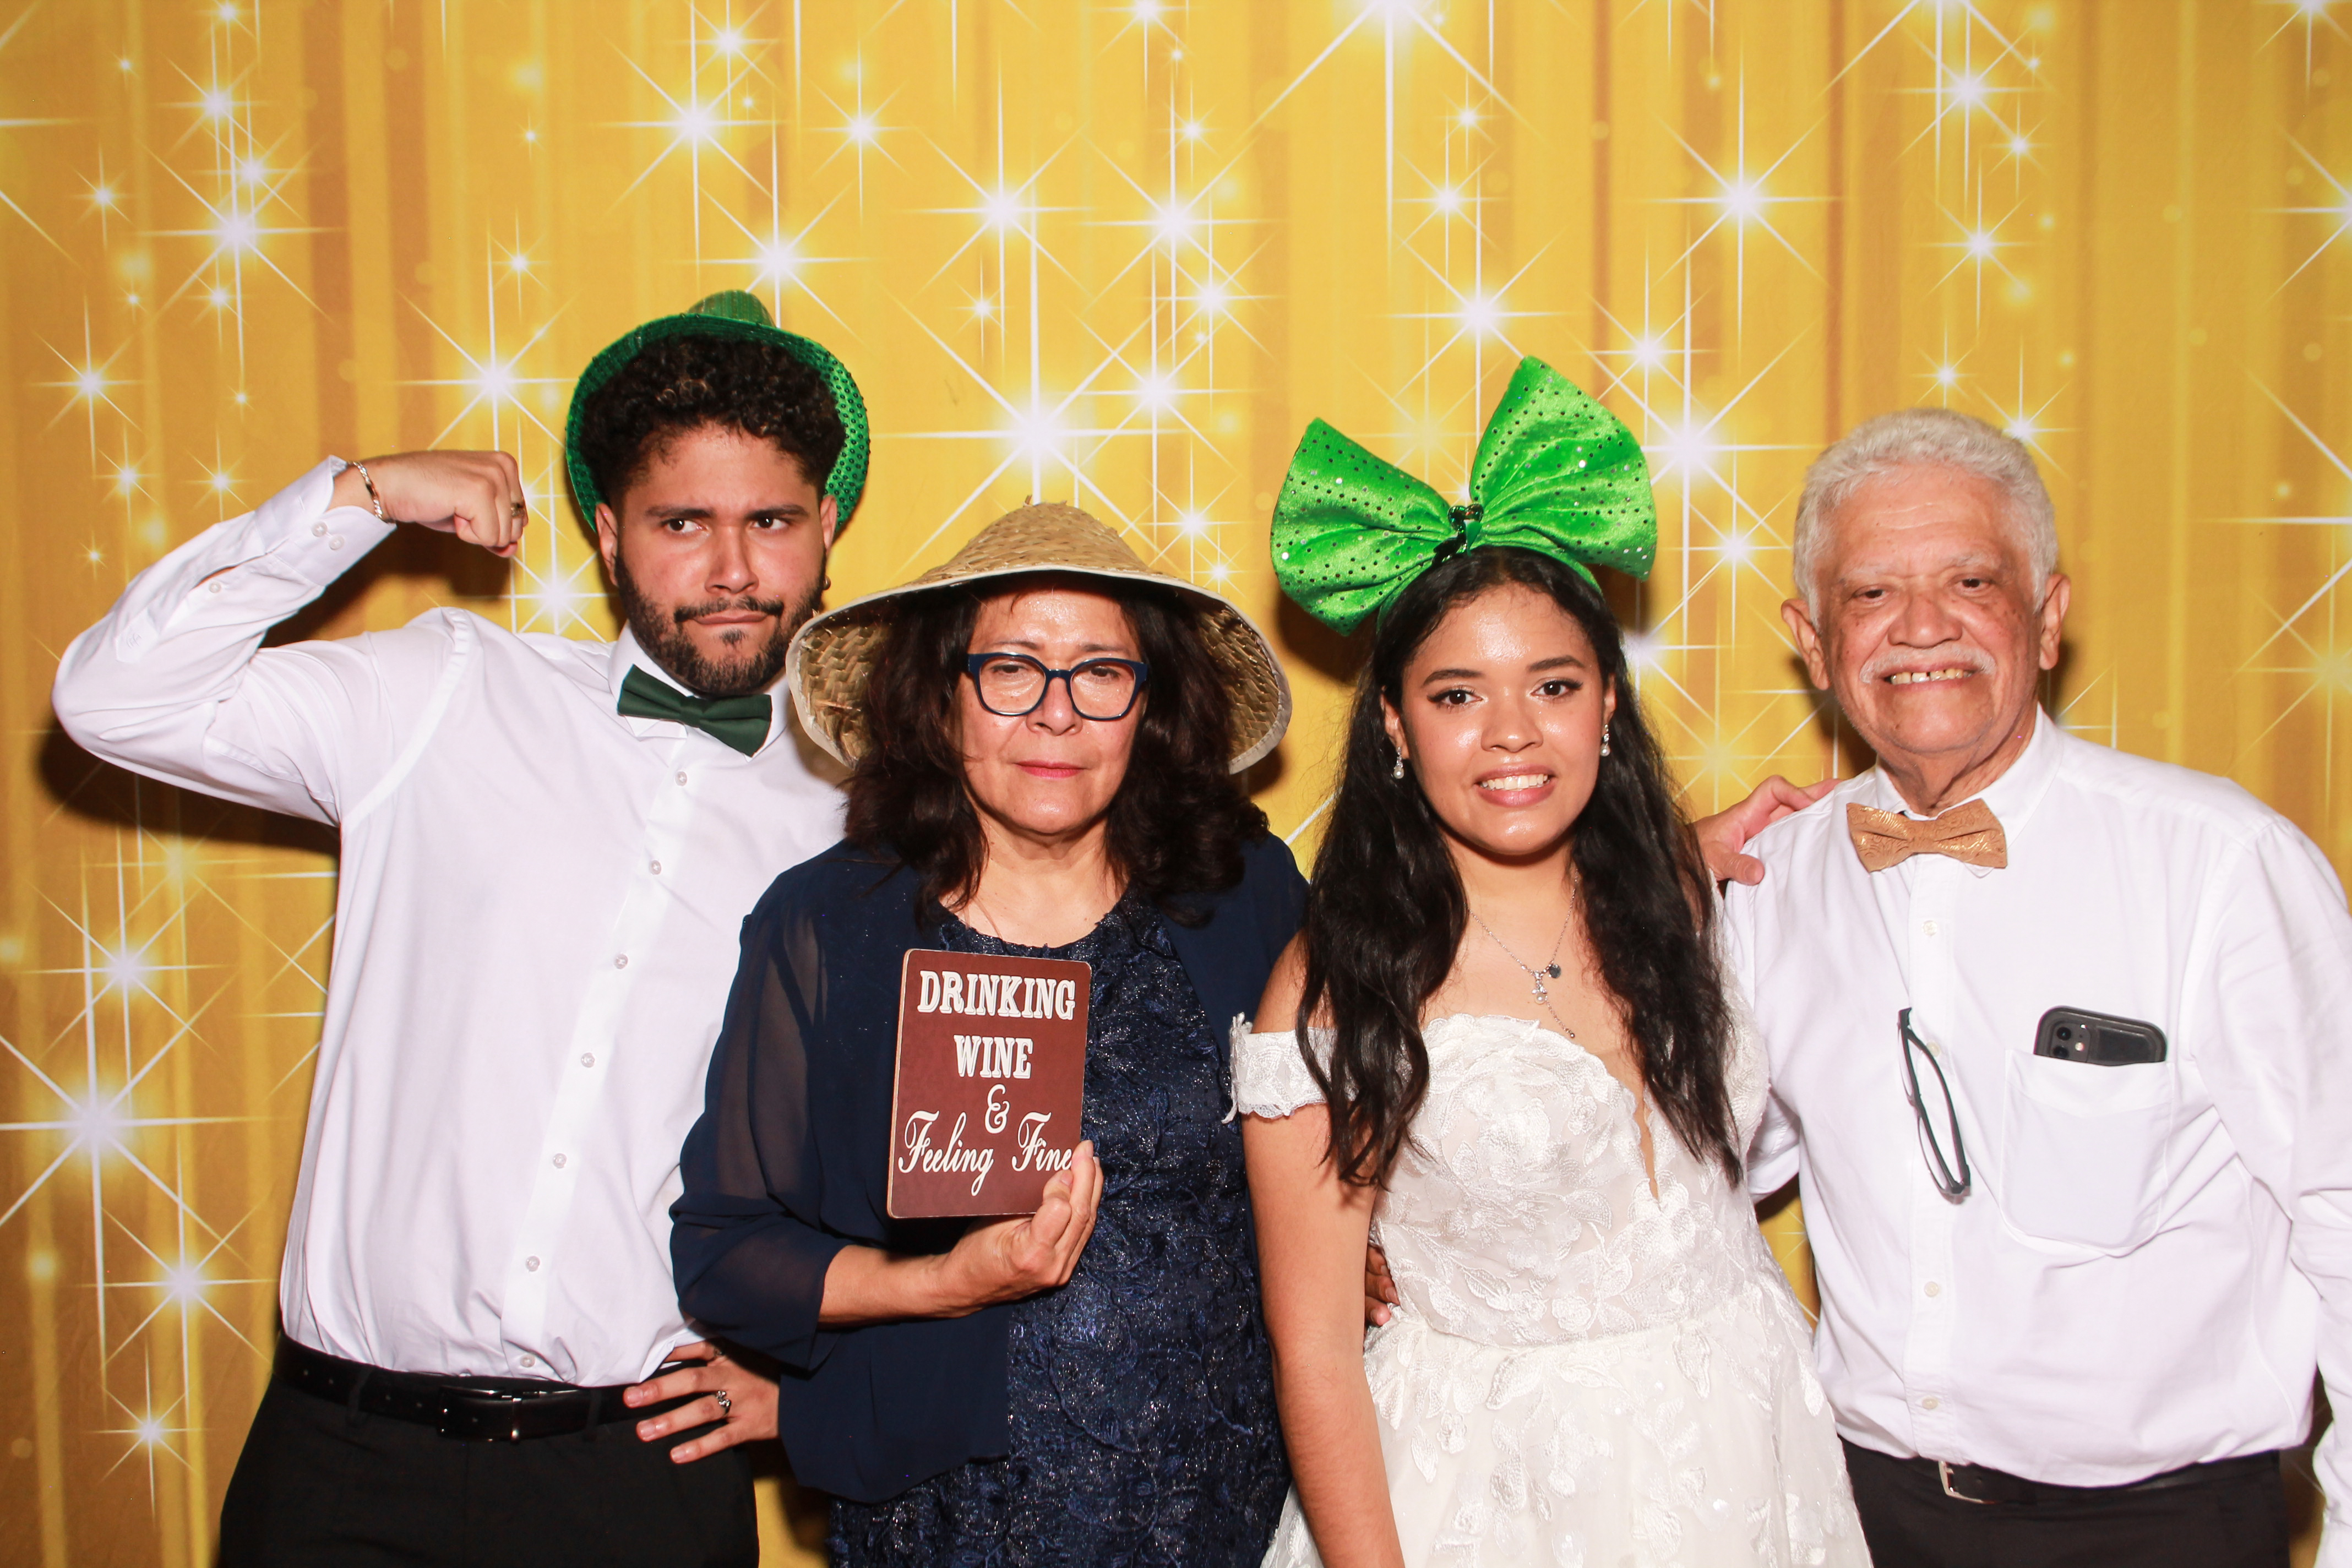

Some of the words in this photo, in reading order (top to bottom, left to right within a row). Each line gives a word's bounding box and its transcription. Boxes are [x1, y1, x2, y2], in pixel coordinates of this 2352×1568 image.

[917, 970, 1076, 1020] DRINKING
[954, 1035, 1033, 1079] WINE
[985, 1084, 1010, 1134] &
[898, 1110, 994, 1196] Feeling
[1011, 1112, 1072, 1172] Fine
